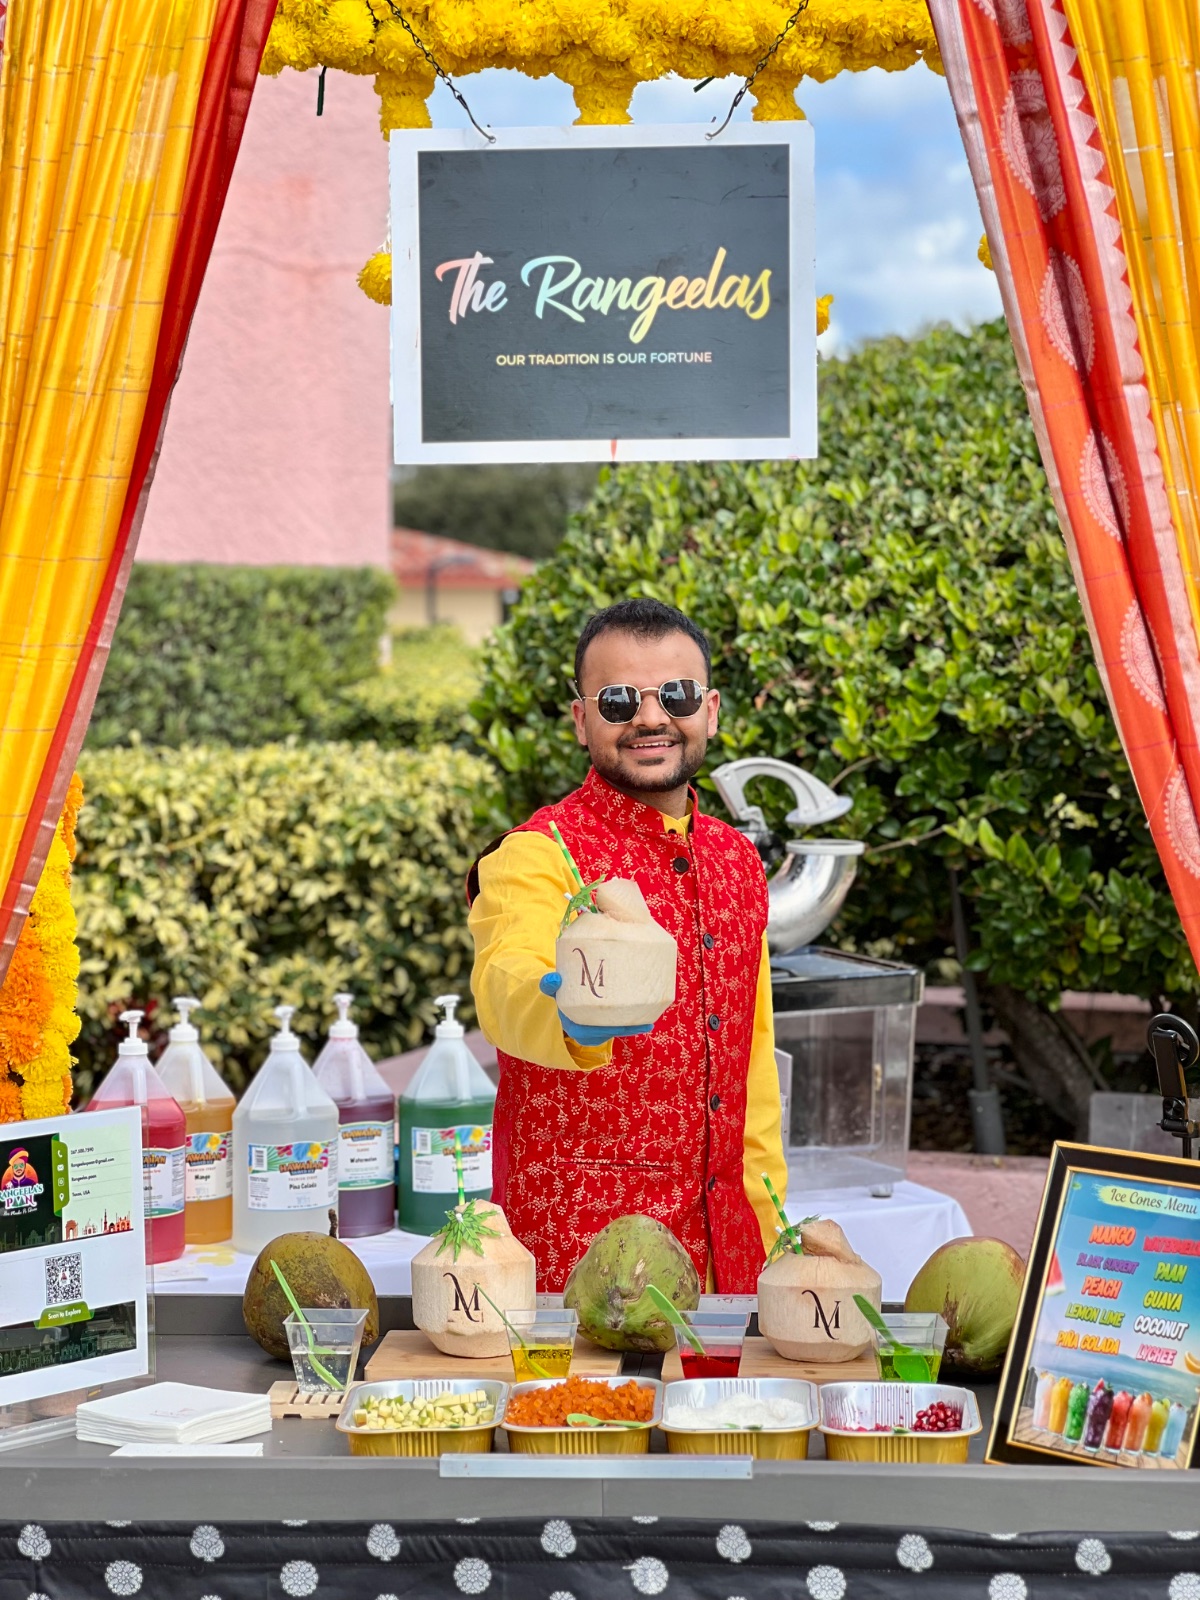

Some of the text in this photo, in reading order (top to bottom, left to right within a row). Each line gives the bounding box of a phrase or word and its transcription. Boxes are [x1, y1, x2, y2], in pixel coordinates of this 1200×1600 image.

[435, 246, 772, 344] The Rangeelas
[496, 352, 712, 366] OUR TRADITION IS OUR FORTUNE
[572, 947, 605, 998] M
[185, 1152, 222, 1164] AWAIIAN
[443, 1145, 486, 1156] HAAIIAN
[279, 1159, 323, 1173] HAWAIIAN
[1110, 1188, 1198, 1214] Ice Cones Menu
[1088, 1224, 1137, 1246] MANGO
[1154, 1261, 1188, 1284] PAAN
[443, 1272, 481, 1323] M
[1081, 1275, 1123, 1300] PEACH
[65, 1308, 82, 1317] Explore
[1143, 1290, 1184, 1312] GUAVA
[801, 1289, 841, 1340] M
[1064, 1302, 1126, 1328] LEMON LIME
[1133, 1315, 1189, 1341] COCONUT
[1080, 1334, 1121, 1356] COLADA
[1135, 1343, 1178, 1366] LYCHEE
